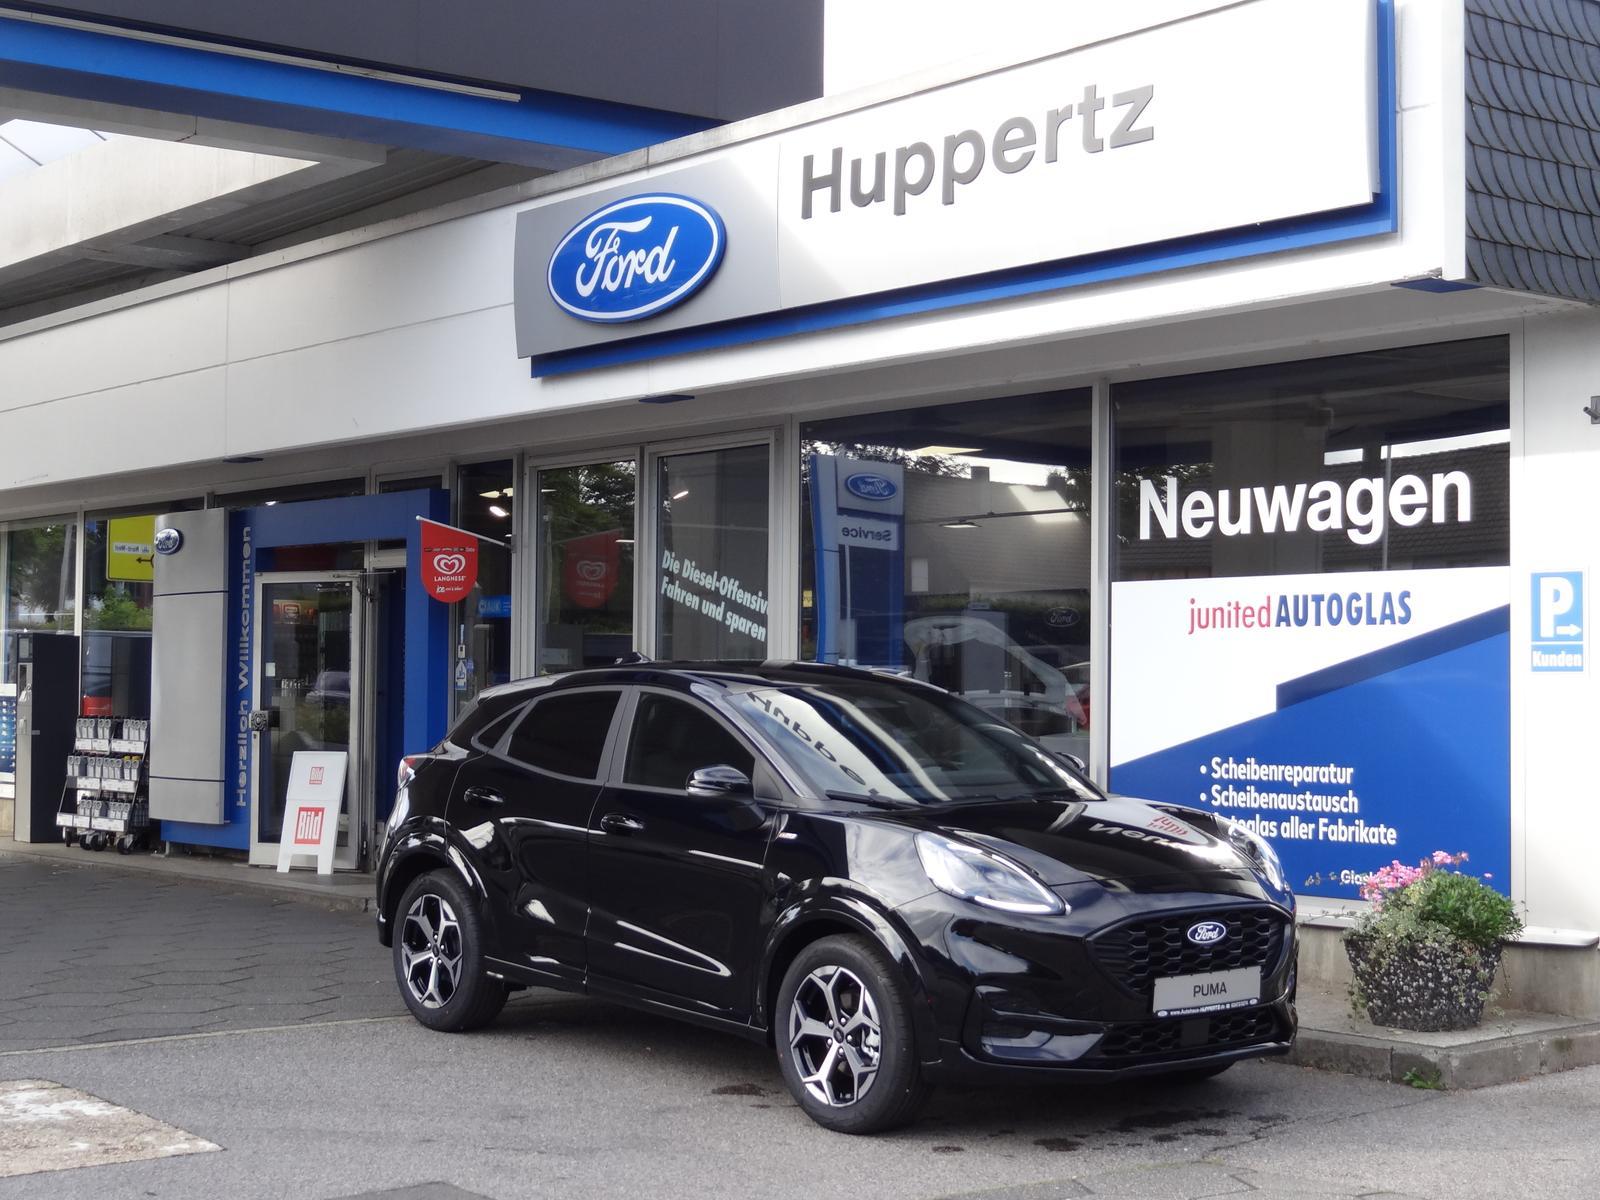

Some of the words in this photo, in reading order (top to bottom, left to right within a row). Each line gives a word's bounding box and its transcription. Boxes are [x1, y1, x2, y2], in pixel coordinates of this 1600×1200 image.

[801, 83, 1155, 220] Huppertz
[574, 214, 679, 298] Ford
[1138, 469, 1474, 545] Neuwagen
[662, 549, 680, 574] Die
[682, 558, 768, 616] Diesel-Offensiv
[661, 575, 700, 610] Fahren
[701, 600, 725, 622] und
[725, 611, 767, 642] sparen
[1539, 575, 1575, 640] P
[1532, 649, 1584, 670] Kunden
[1211, 757, 1355, 788] Scheibenreparatur
[1211, 785, 1360, 814] Scheibenaustausch
[297, 811, 322, 840] Bild
[1281, 816, 1316, 841] aller
[1318, 818, 1398, 845] Fabrikate
[1195, 925, 1218, 940] Ford
[1193, 982, 1228, 998] PUMA
